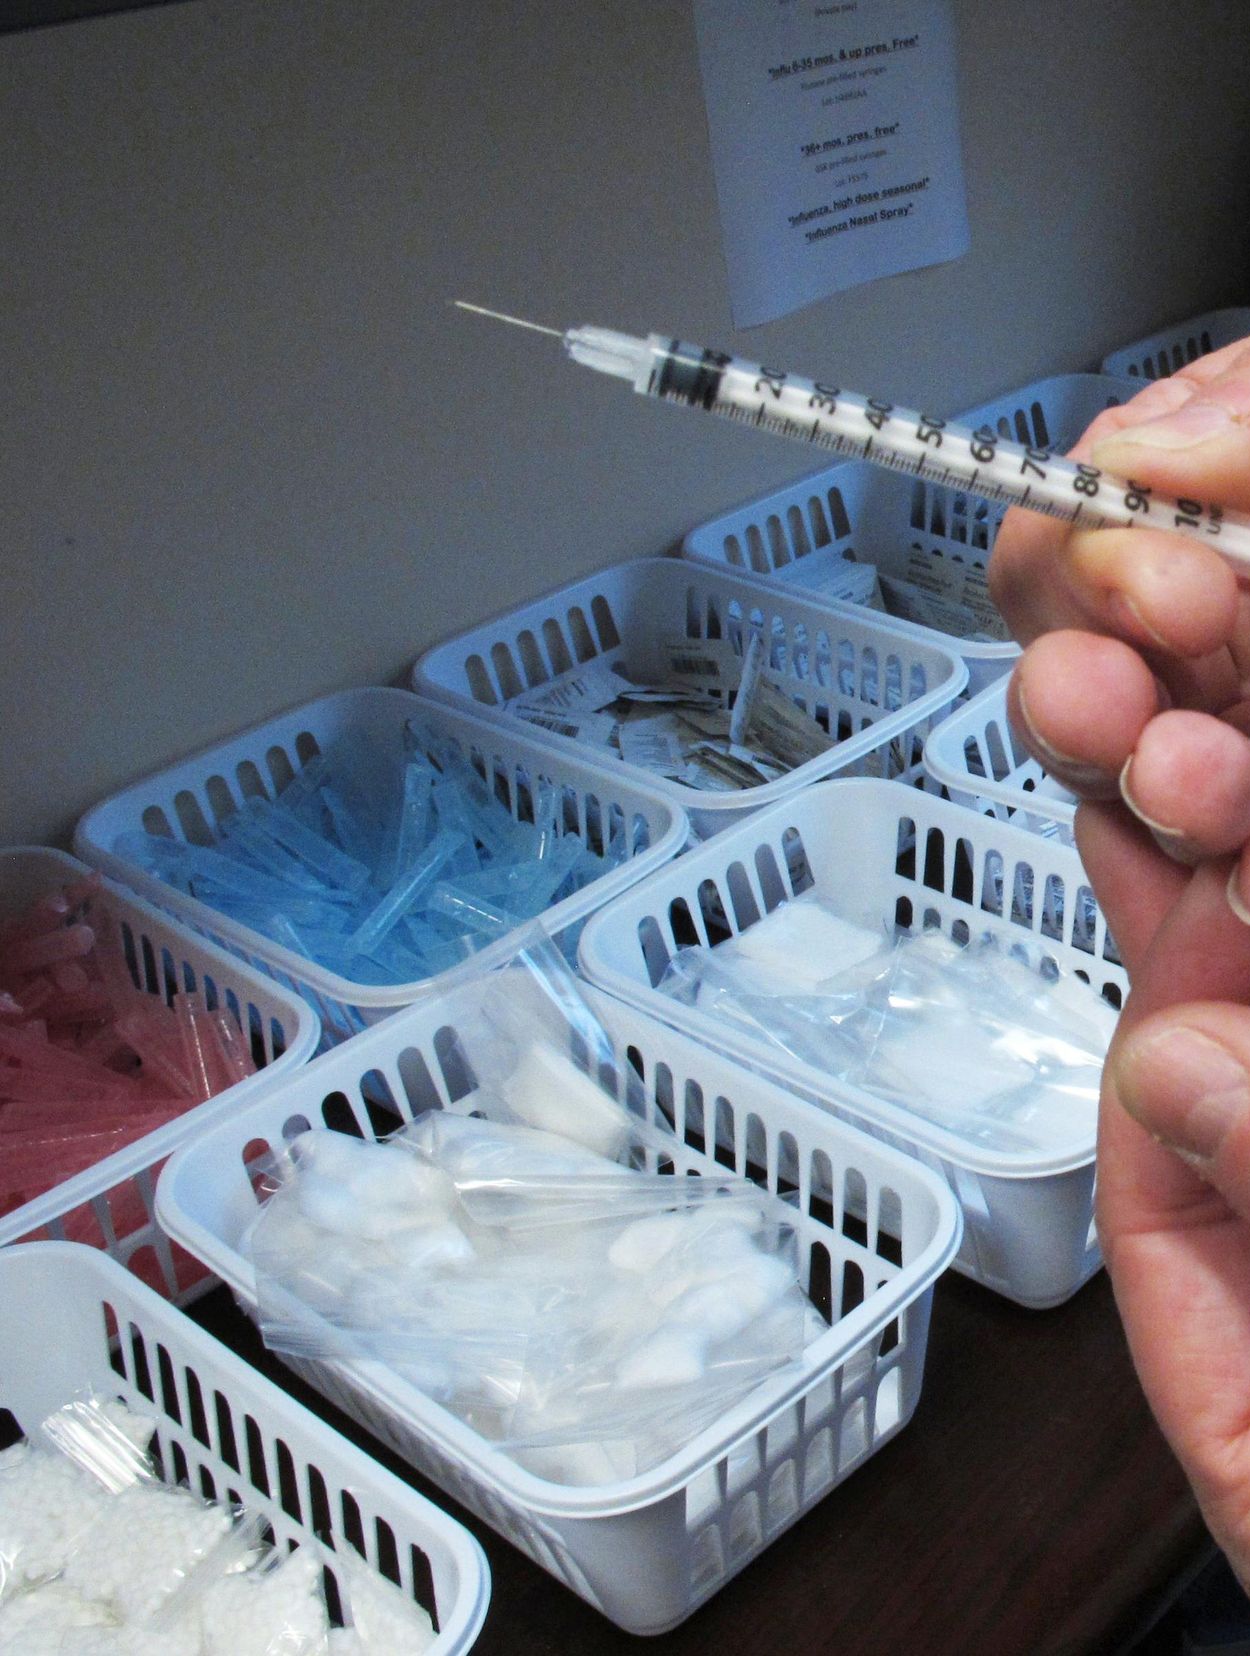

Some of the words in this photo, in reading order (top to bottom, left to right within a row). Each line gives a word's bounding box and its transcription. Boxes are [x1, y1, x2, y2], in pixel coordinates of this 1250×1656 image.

[839, 49, 846, 60] &
[848, 48, 862, 59] up
[833, 197, 853, 211] high
[855, 190, 879, 204] dose
[849, 211, 878, 228] Nasal
[755, 366, 787, 400] 20
[809, 383, 841, 414] 30
[865, 398, 893, 430] 40
[916, 414, 946, 448] 50
[970, 428, 998, 463] 60
[1020, 445, 1050, 480] 70
[1073, 463, 1102, 497] 80
